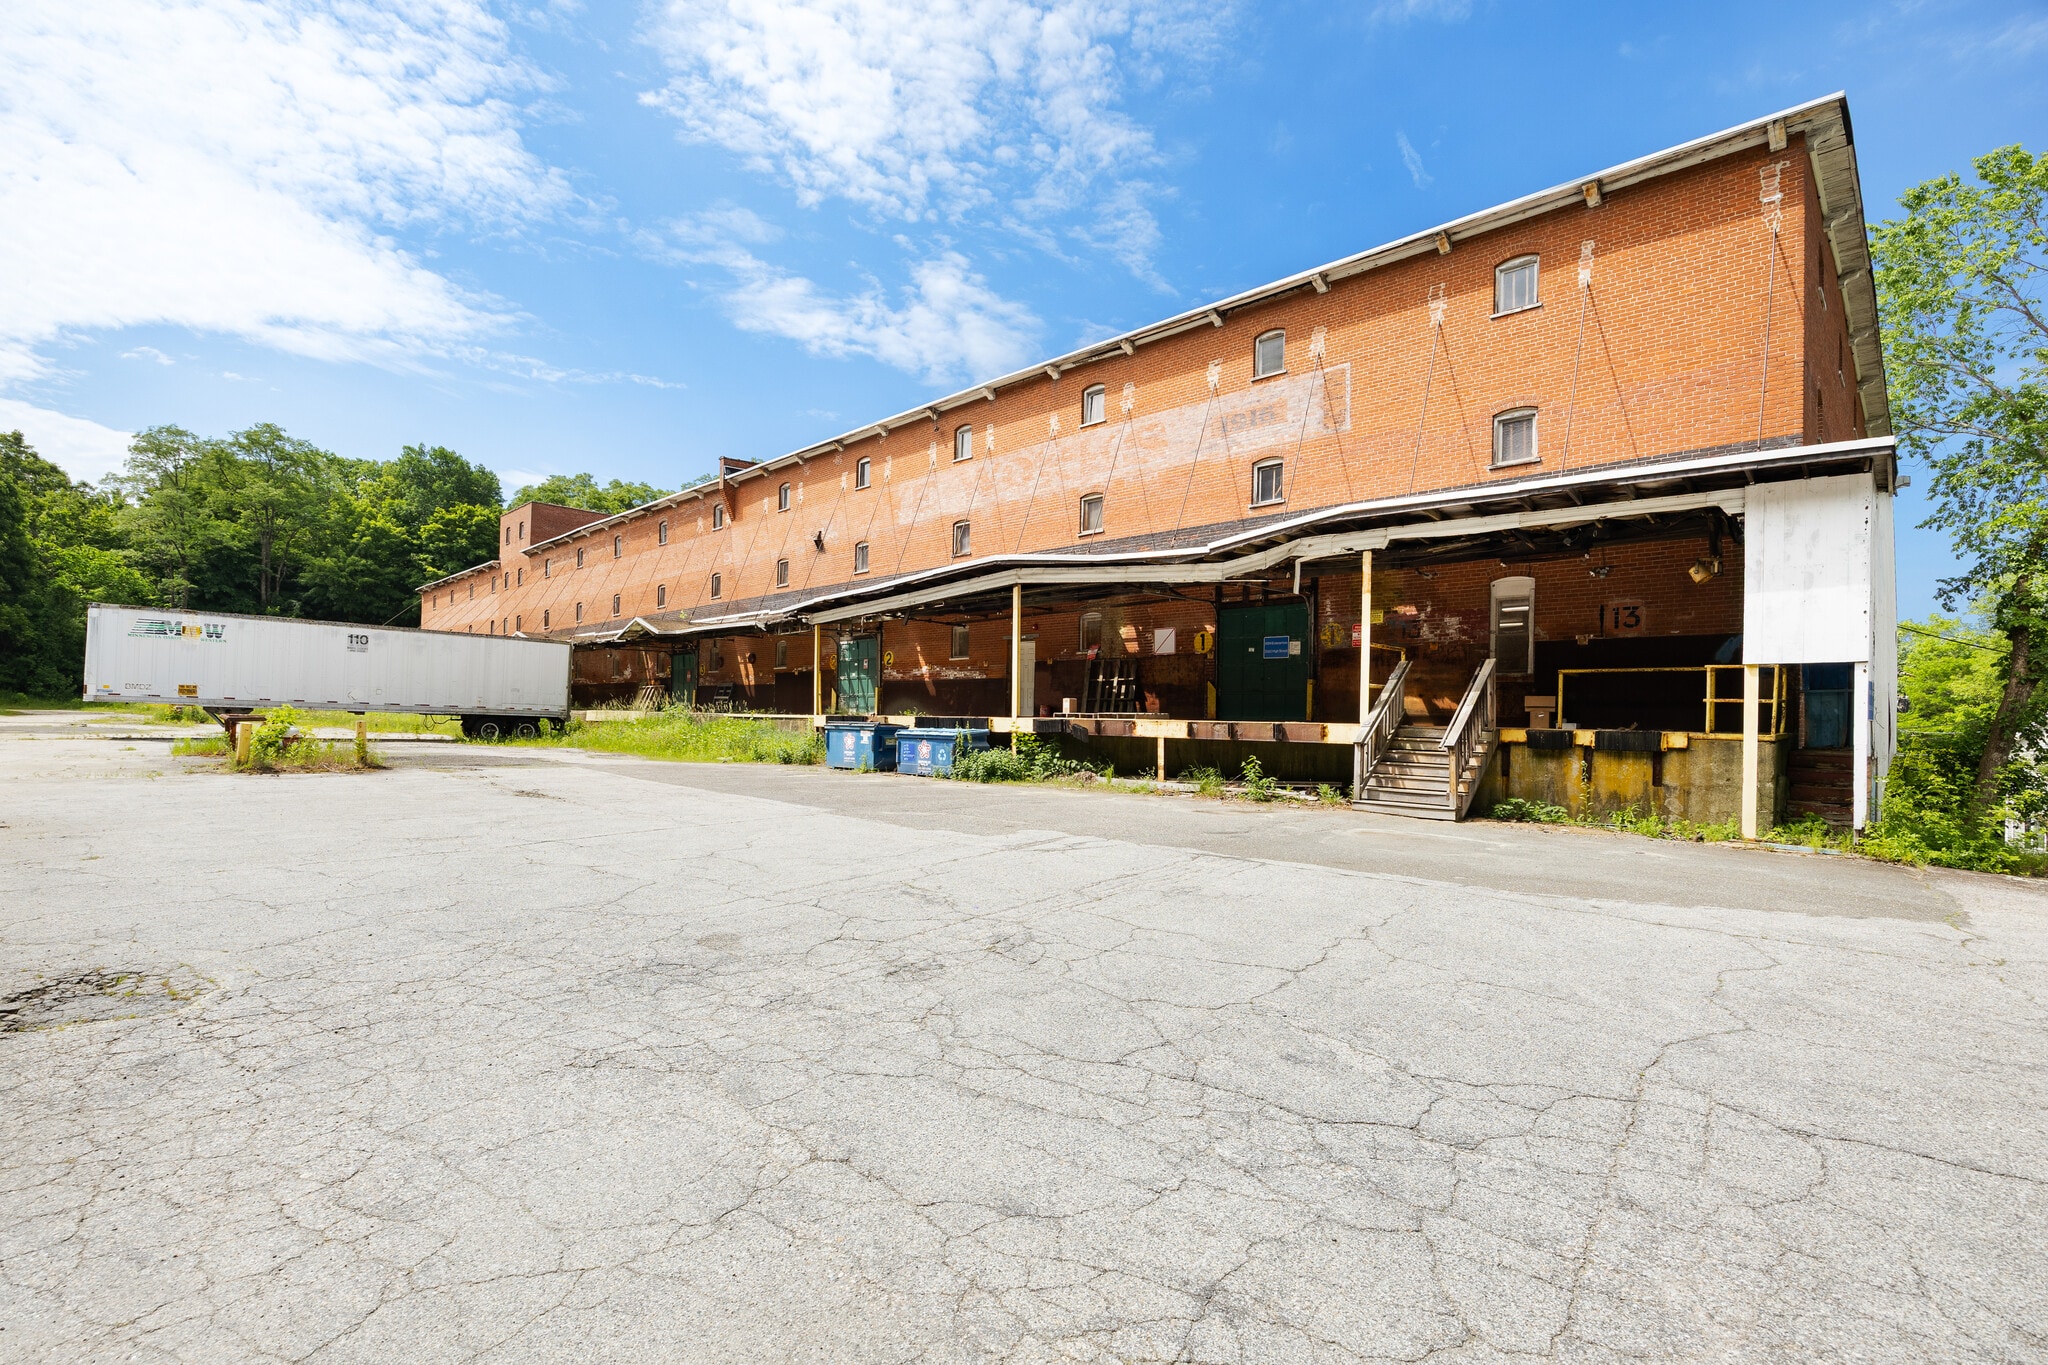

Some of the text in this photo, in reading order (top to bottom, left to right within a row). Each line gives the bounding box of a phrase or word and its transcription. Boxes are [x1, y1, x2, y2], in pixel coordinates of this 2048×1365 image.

[347, 634, 369, 645] 110
[1200, 633, 1205, 651] 1
[885, 652, 892, 665] 2
